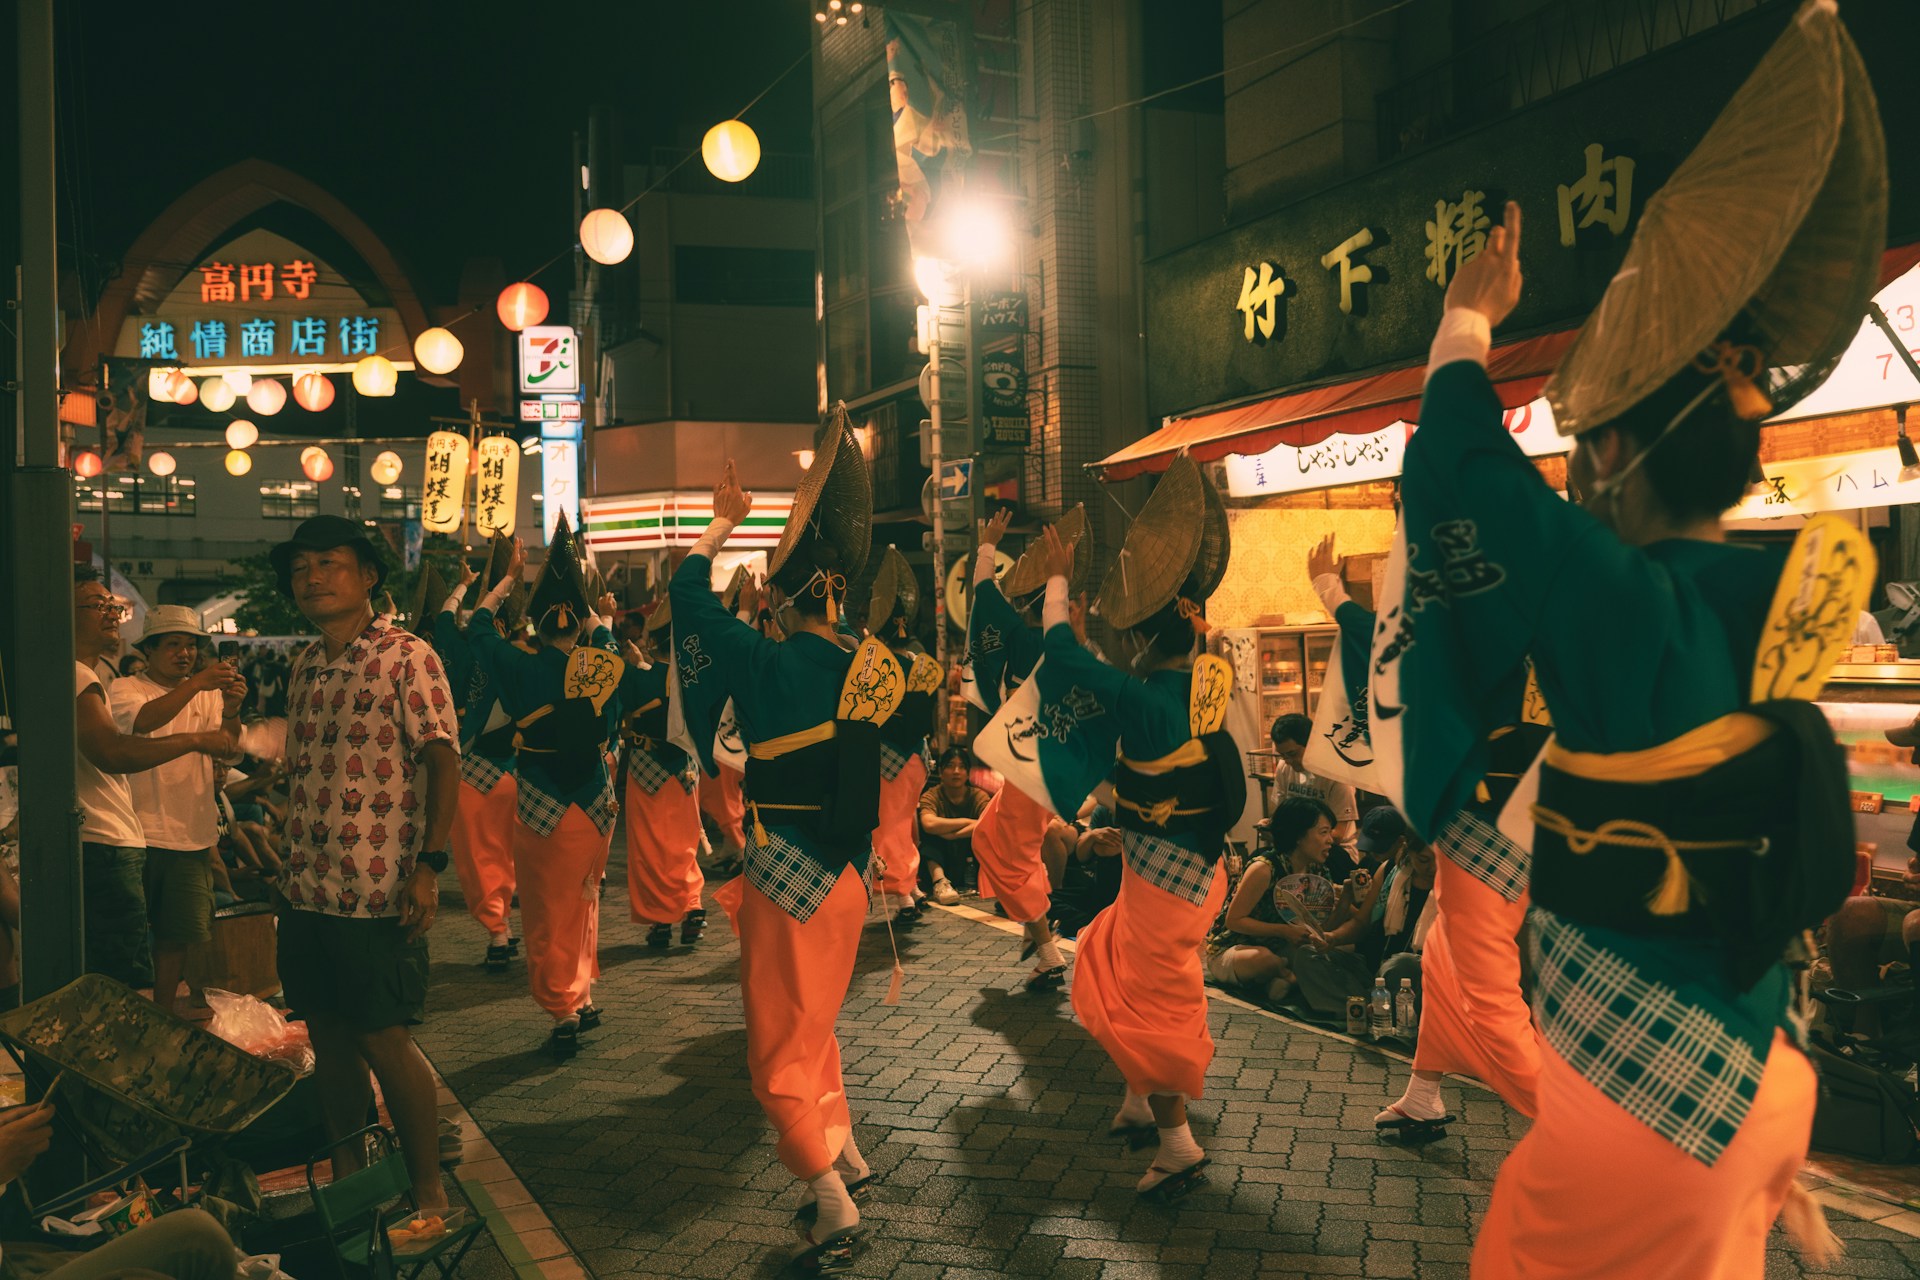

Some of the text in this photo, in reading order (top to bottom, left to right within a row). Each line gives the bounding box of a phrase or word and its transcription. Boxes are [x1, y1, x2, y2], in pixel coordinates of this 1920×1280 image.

[199, 260, 319, 304] 高円寺
[139, 315, 380, 361] 純情商店街
[427, 437, 460, 452] 高円寺
[480, 443, 513, 458] 高円寺
[1295, 433, 1390, 475] しゃぶしゃぶ
[1836, 469, 1890, 493] ハム
